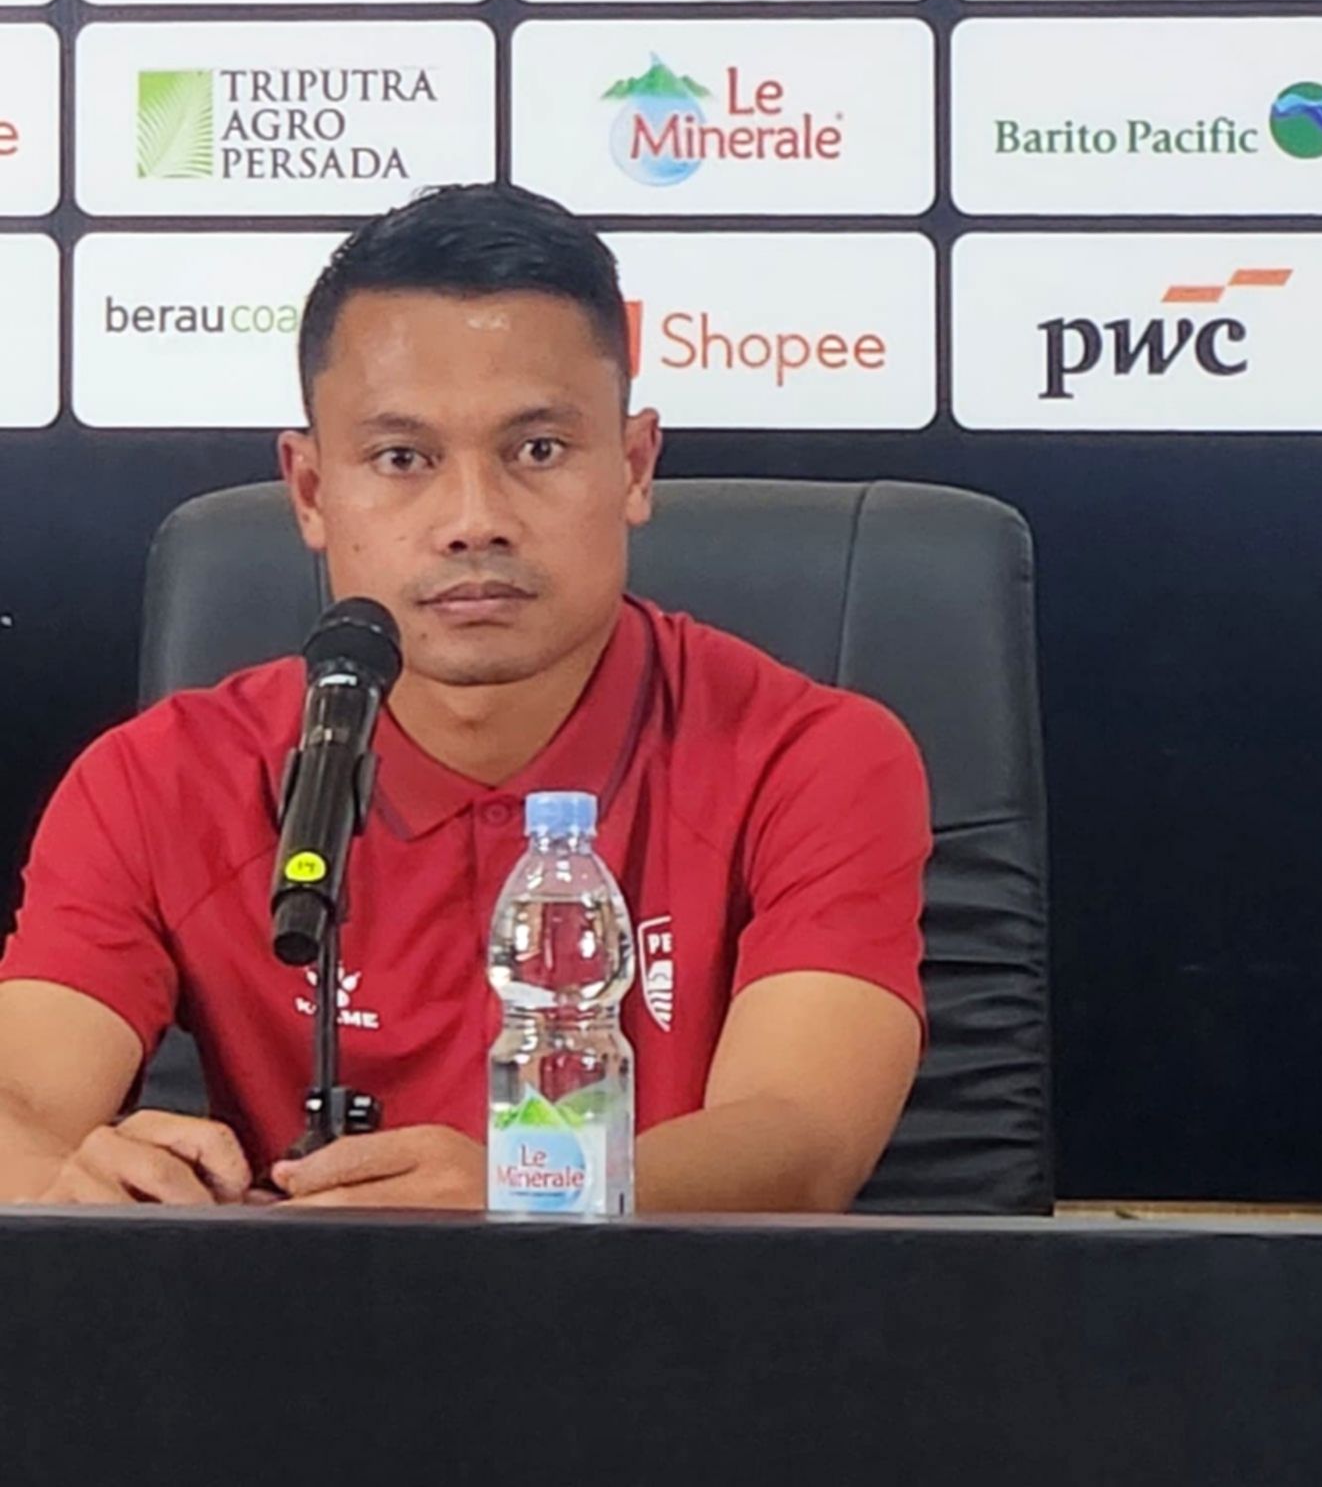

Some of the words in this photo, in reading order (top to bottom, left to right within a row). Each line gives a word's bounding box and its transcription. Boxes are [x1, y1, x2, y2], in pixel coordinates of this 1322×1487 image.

[220, 69, 437, 102] TRIPUTRA
[728, 69, 782, 116] Le
[222, 109, 345, 141] AGRO
[632, 117, 838, 158] Minerale
[995, 120, 1117, 154] Barito
[1127, 116, 1258, 154] Pacific
[222, 147, 409, 179] PERSADA
[105, 295, 298, 334] beraucoa
[661, 312, 886, 387] Shopee
[1037, 317, 1248, 400] pwc
[521, 1142, 547, 1168] Le
